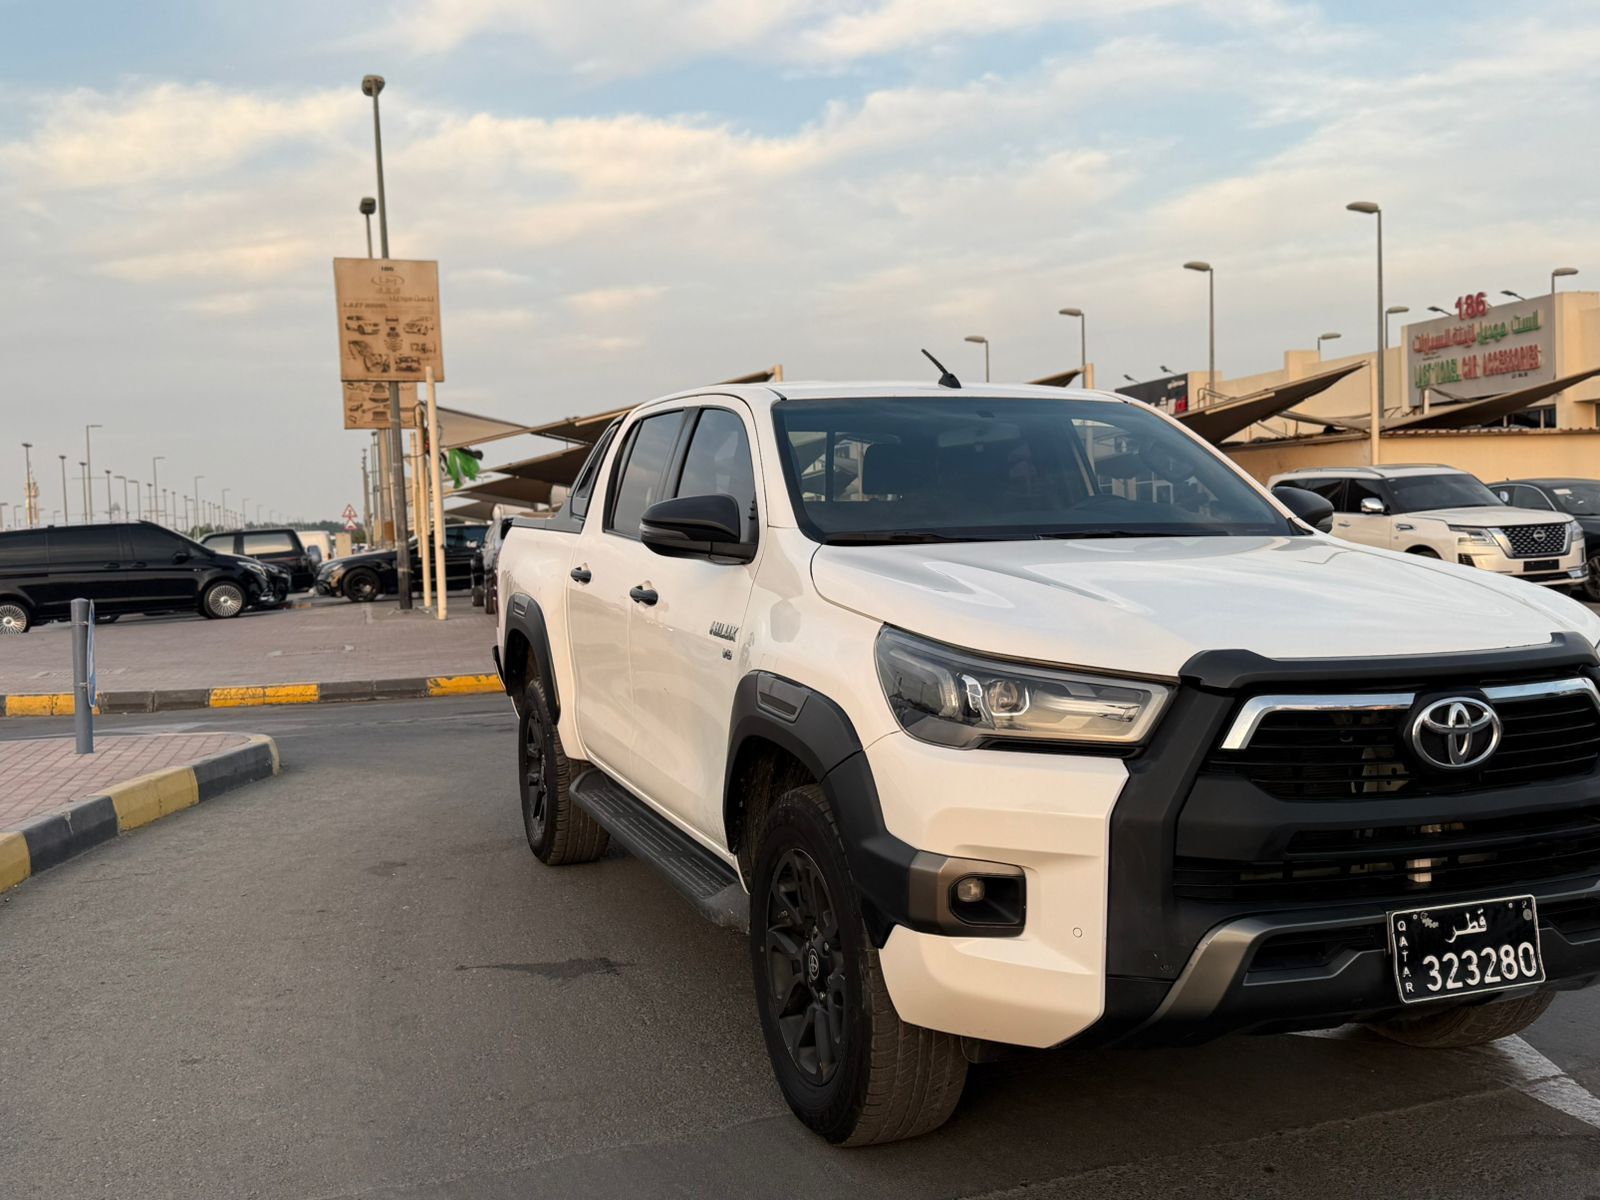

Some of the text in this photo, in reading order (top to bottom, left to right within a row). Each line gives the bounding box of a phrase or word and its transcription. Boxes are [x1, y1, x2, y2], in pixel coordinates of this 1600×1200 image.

[1455, 291, 1488, 321] 186
[1413, 328, 1453, 356] السيارات
[1462, 354, 1480, 380] CAR
[1445, 908, 1488, 943] قطر
[1397, 920, 1415, 993] QATAR
[1422, 941, 1537, 992] 323280
